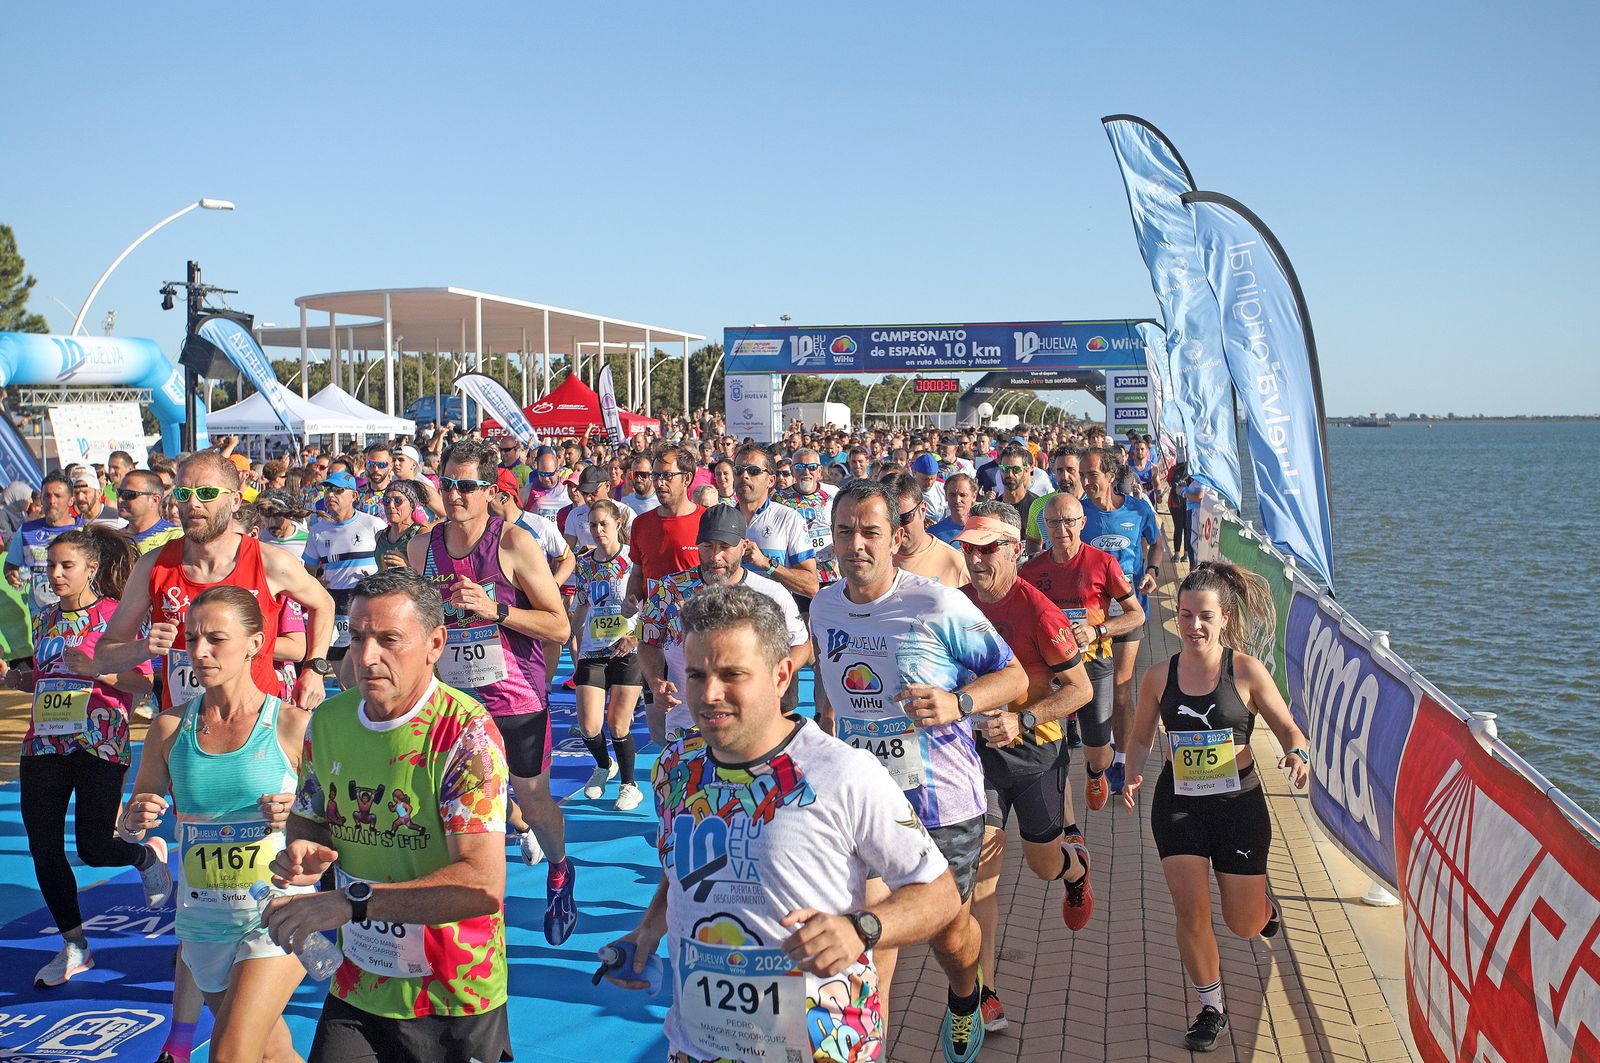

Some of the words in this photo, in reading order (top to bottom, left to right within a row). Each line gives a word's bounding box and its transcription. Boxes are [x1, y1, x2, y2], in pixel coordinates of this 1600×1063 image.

[871, 330, 967, 342] CAMPEONATO
[1038, 337, 1078, 349] HUELVA
[870, 346, 885, 357] de
[888, 344, 937, 356] ESPAÑA
[944, 343, 967, 357] 10
[972, 342, 1001, 357] km
[934, 358, 966, 366] Absoluto
[1100, 537, 1123, 549] Ford
[594, 617, 621, 629] 1524
[474, 630, 493, 639] 2023
[848, 636, 887, 650] HUELVA
[451, 643, 486, 662] 750
[43, 693, 72, 709] 904
[851, 696, 883, 709] WiHu
[882, 721, 907, 733] 2023
[1207, 733, 1227, 743] 2023
[1183, 748, 1218, 766] 875
[197, 830, 217, 838] HUELVA
[730, 817, 762, 840] HU
[397, 833, 431, 850] FIT
[729, 838, 760, 861] EL
[195, 845, 261, 870] 1167
[731, 859, 761, 882] VA
[220, 873, 236, 881] LOLA
[730, 884, 753, 894] PUERTA
[753, 886, 764, 896] DEL
[222, 893, 247, 901] Syrluz
[713, 894, 766, 904] DESCUBRIMIENTO
[380, 940, 405, 951] MANUEL
[368, 956, 393, 968] Syrluz
[698, 952, 724, 966] HUELVA
[755, 954, 793, 972] 2023
[696, 975, 780, 1015] 1291
[726, 1018, 754, 1030] PEDRO
[700, 1021, 737, 1037] MARQUEZ
[738, 1030, 787, 1043] RODRIGUEZ
[735, 1042, 767, 1057] Syrluz
